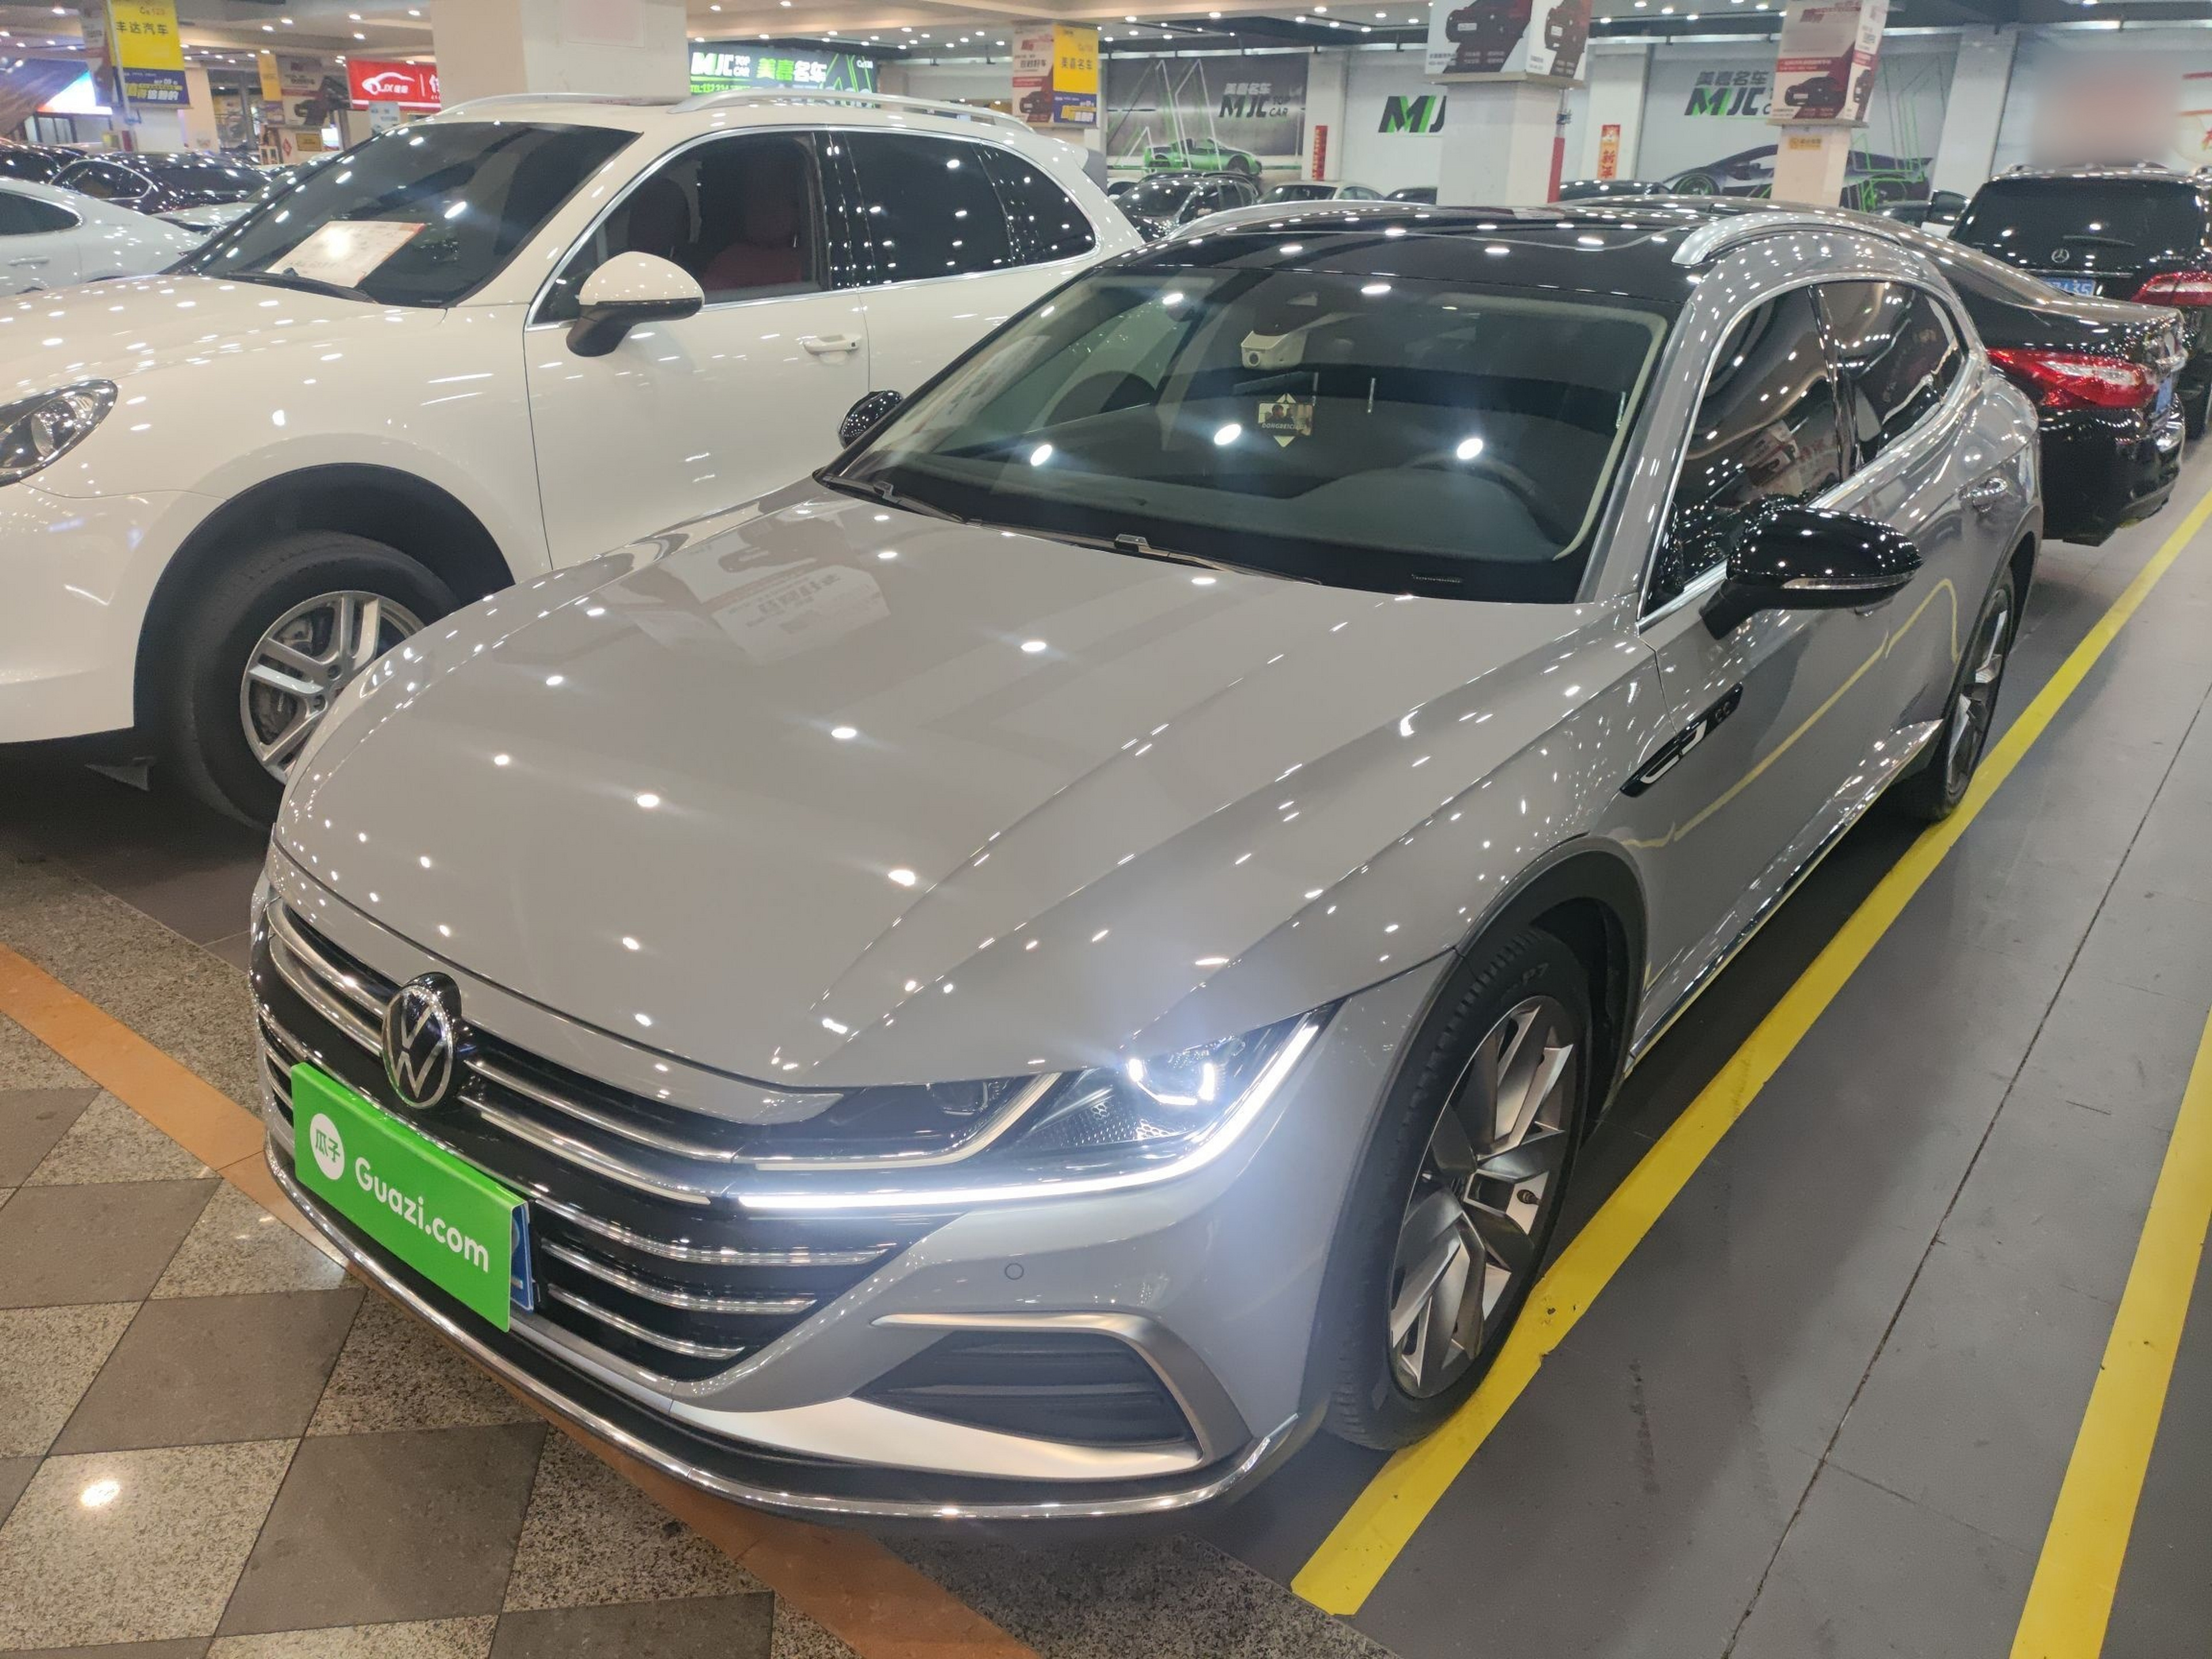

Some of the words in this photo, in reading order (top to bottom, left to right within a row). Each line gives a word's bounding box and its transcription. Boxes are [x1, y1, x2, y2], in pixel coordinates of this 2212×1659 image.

[116, 21, 169, 35] 丰达汽车
[1269, 108, 1289, 116] CAR
[1684, 87, 1767, 115] MJC
[315, 1128, 340, 1163] 瓜子
[355, 1156, 489, 1273] Guazi.com
